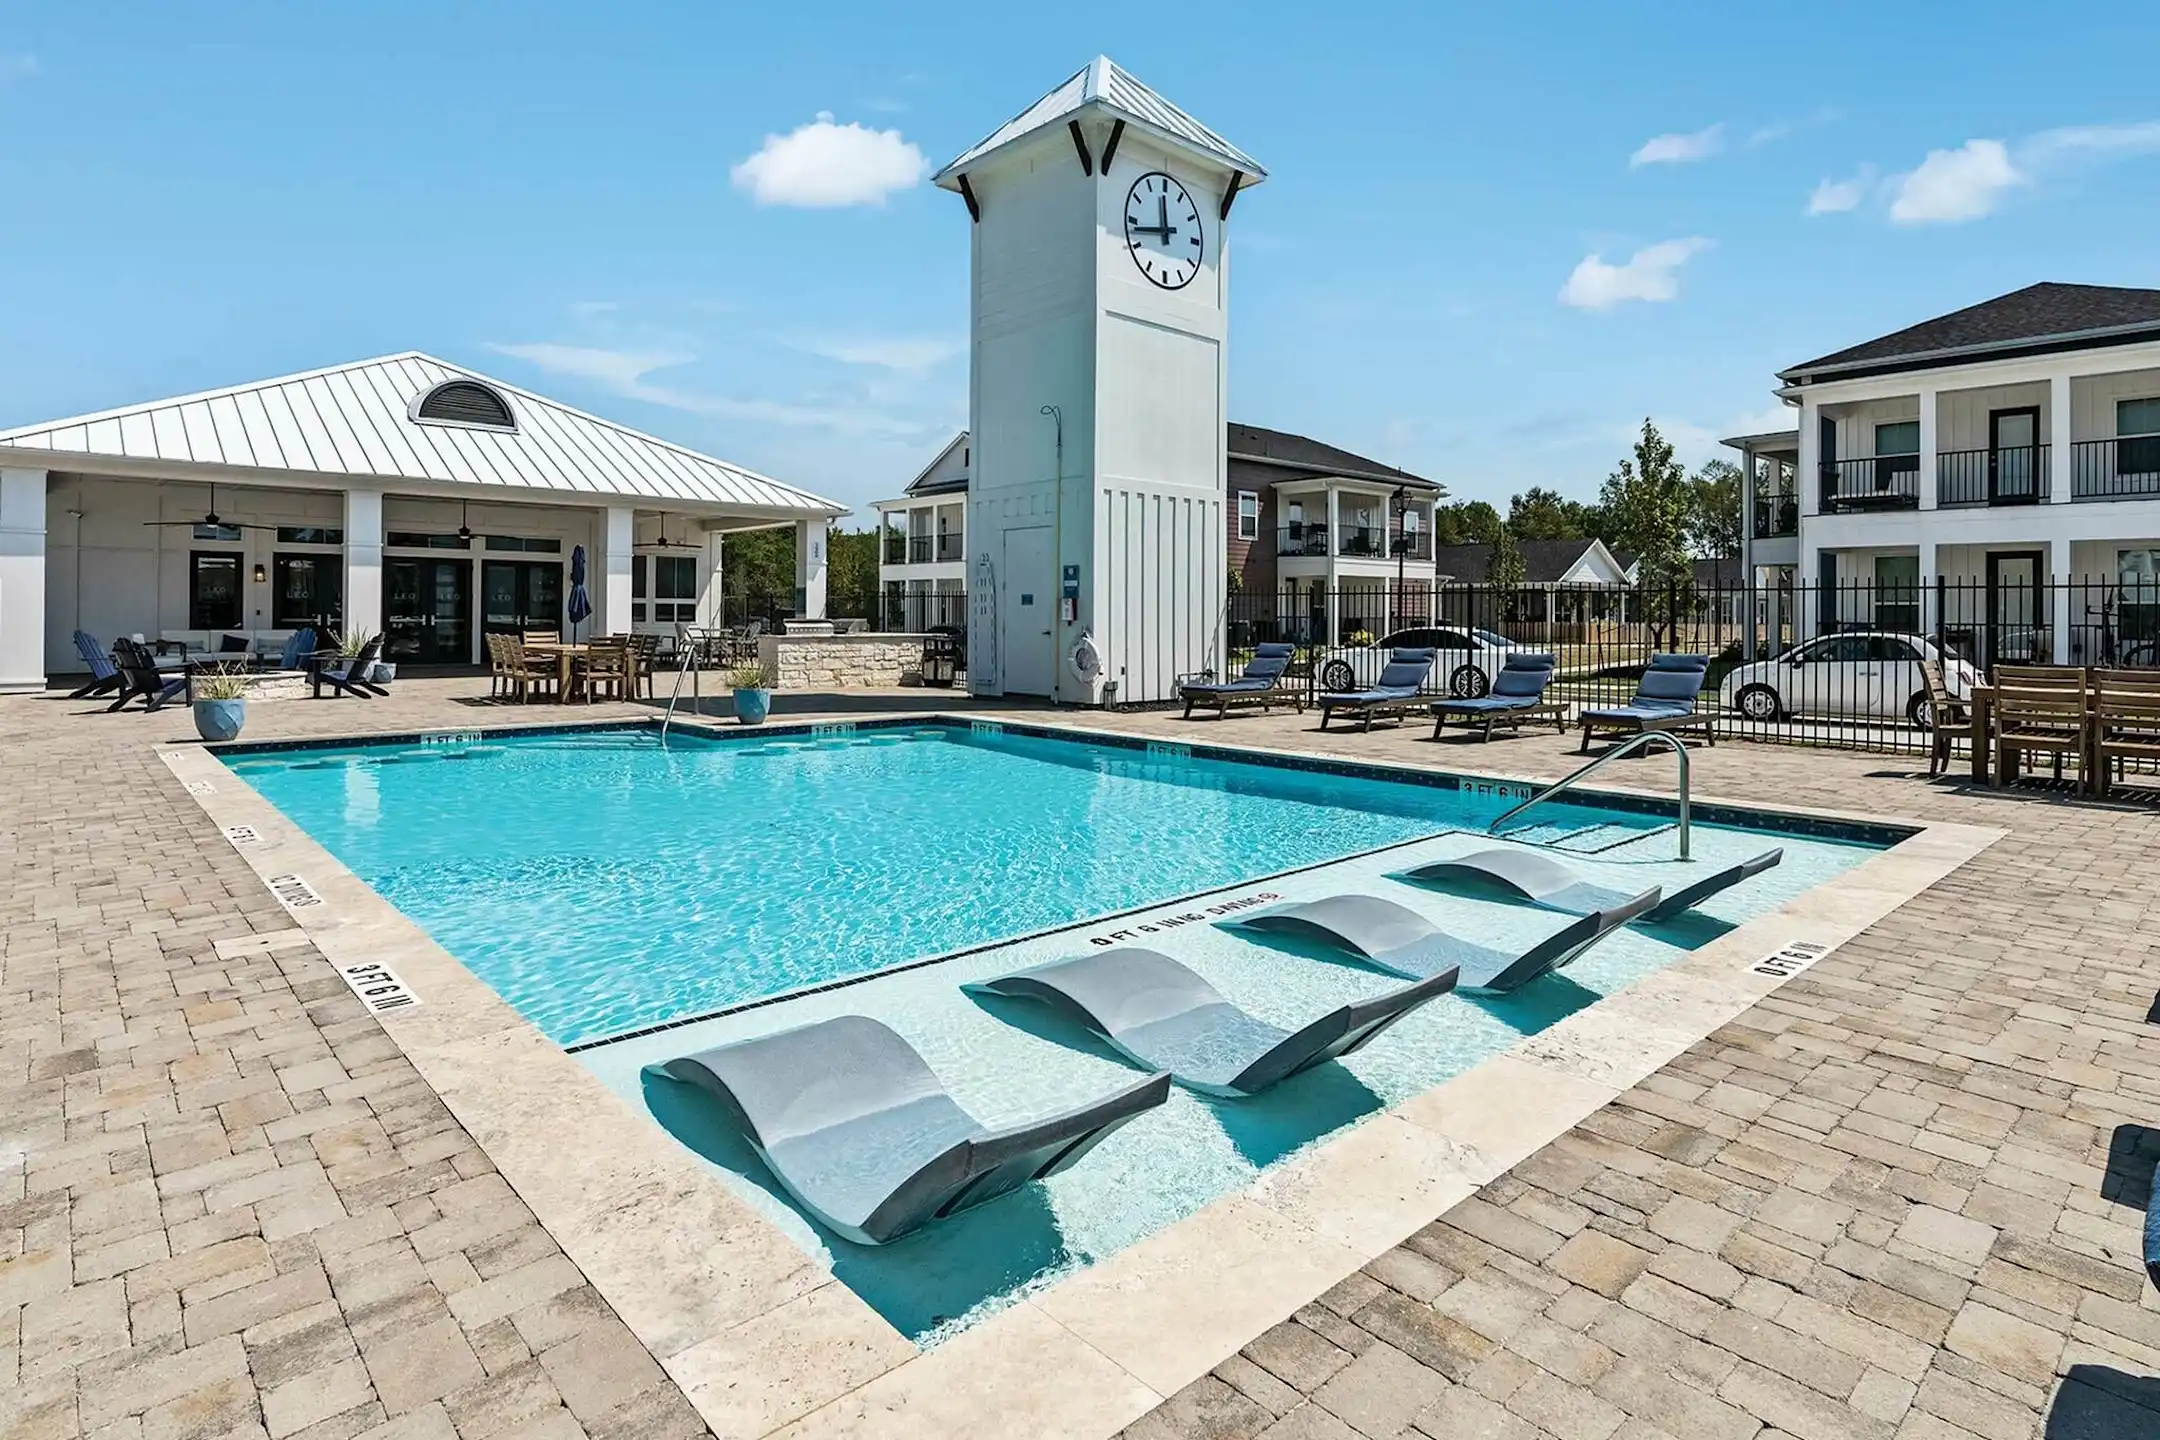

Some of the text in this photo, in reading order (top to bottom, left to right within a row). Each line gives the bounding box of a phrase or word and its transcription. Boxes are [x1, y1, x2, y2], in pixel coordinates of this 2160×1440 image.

[393, 592, 416, 600] LEO
[437, 735, 449, 743] FT
[1478, 783, 1493, 795] FT
[1499, 786, 1508, 797] 6
[1515, 787, 1529, 800] IN
[1109, 929, 1139, 941] FT
[1137, 924, 1160, 932] 6
[1780, 951, 1813, 960] 6
[1763, 956, 1804, 970] FT
[1753, 966, 1789, 977] 0
[347, 964, 415, 1011] 3 FT 6 IN
